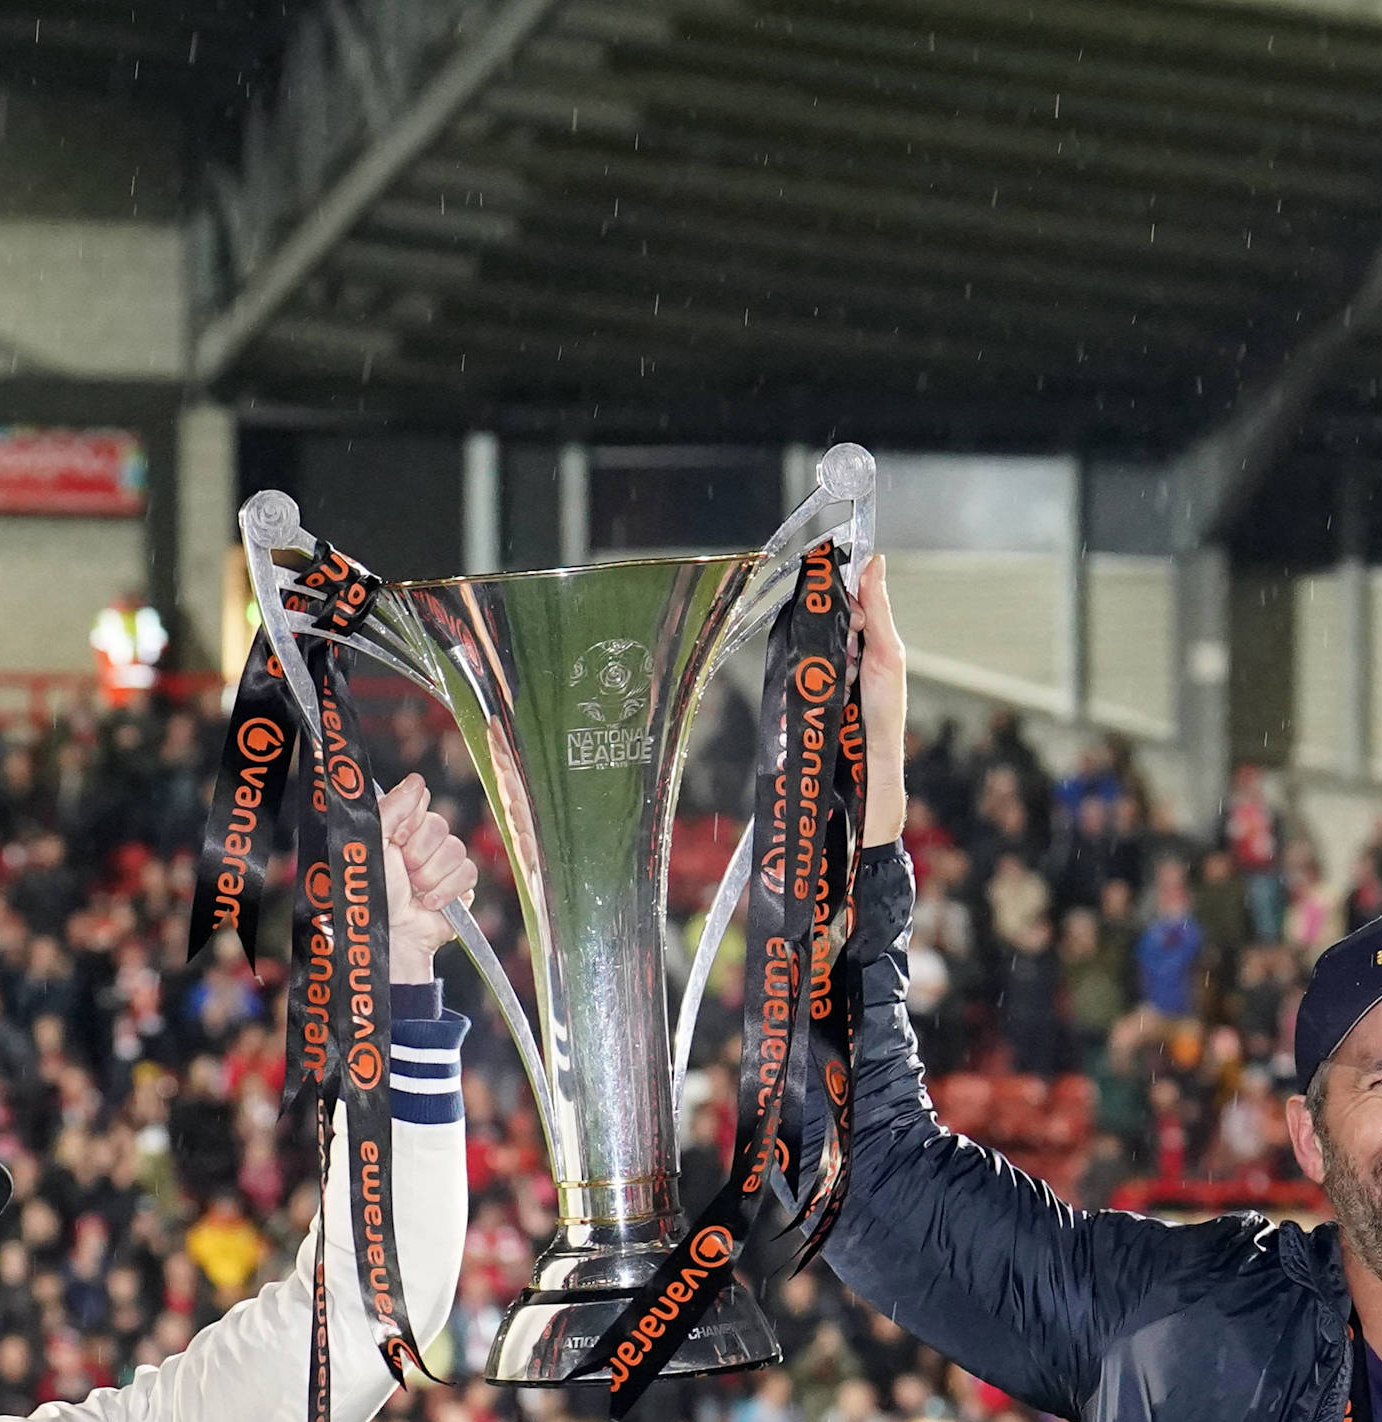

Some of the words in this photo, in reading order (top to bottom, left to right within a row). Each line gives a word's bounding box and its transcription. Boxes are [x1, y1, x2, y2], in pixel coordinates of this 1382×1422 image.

[568, 727, 650, 748] NATIONAL
[568, 736, 652, 766] LEAGUE
[794, 706, 825, 900] vanarama
[343, 841, 375, 1039] vanarama
